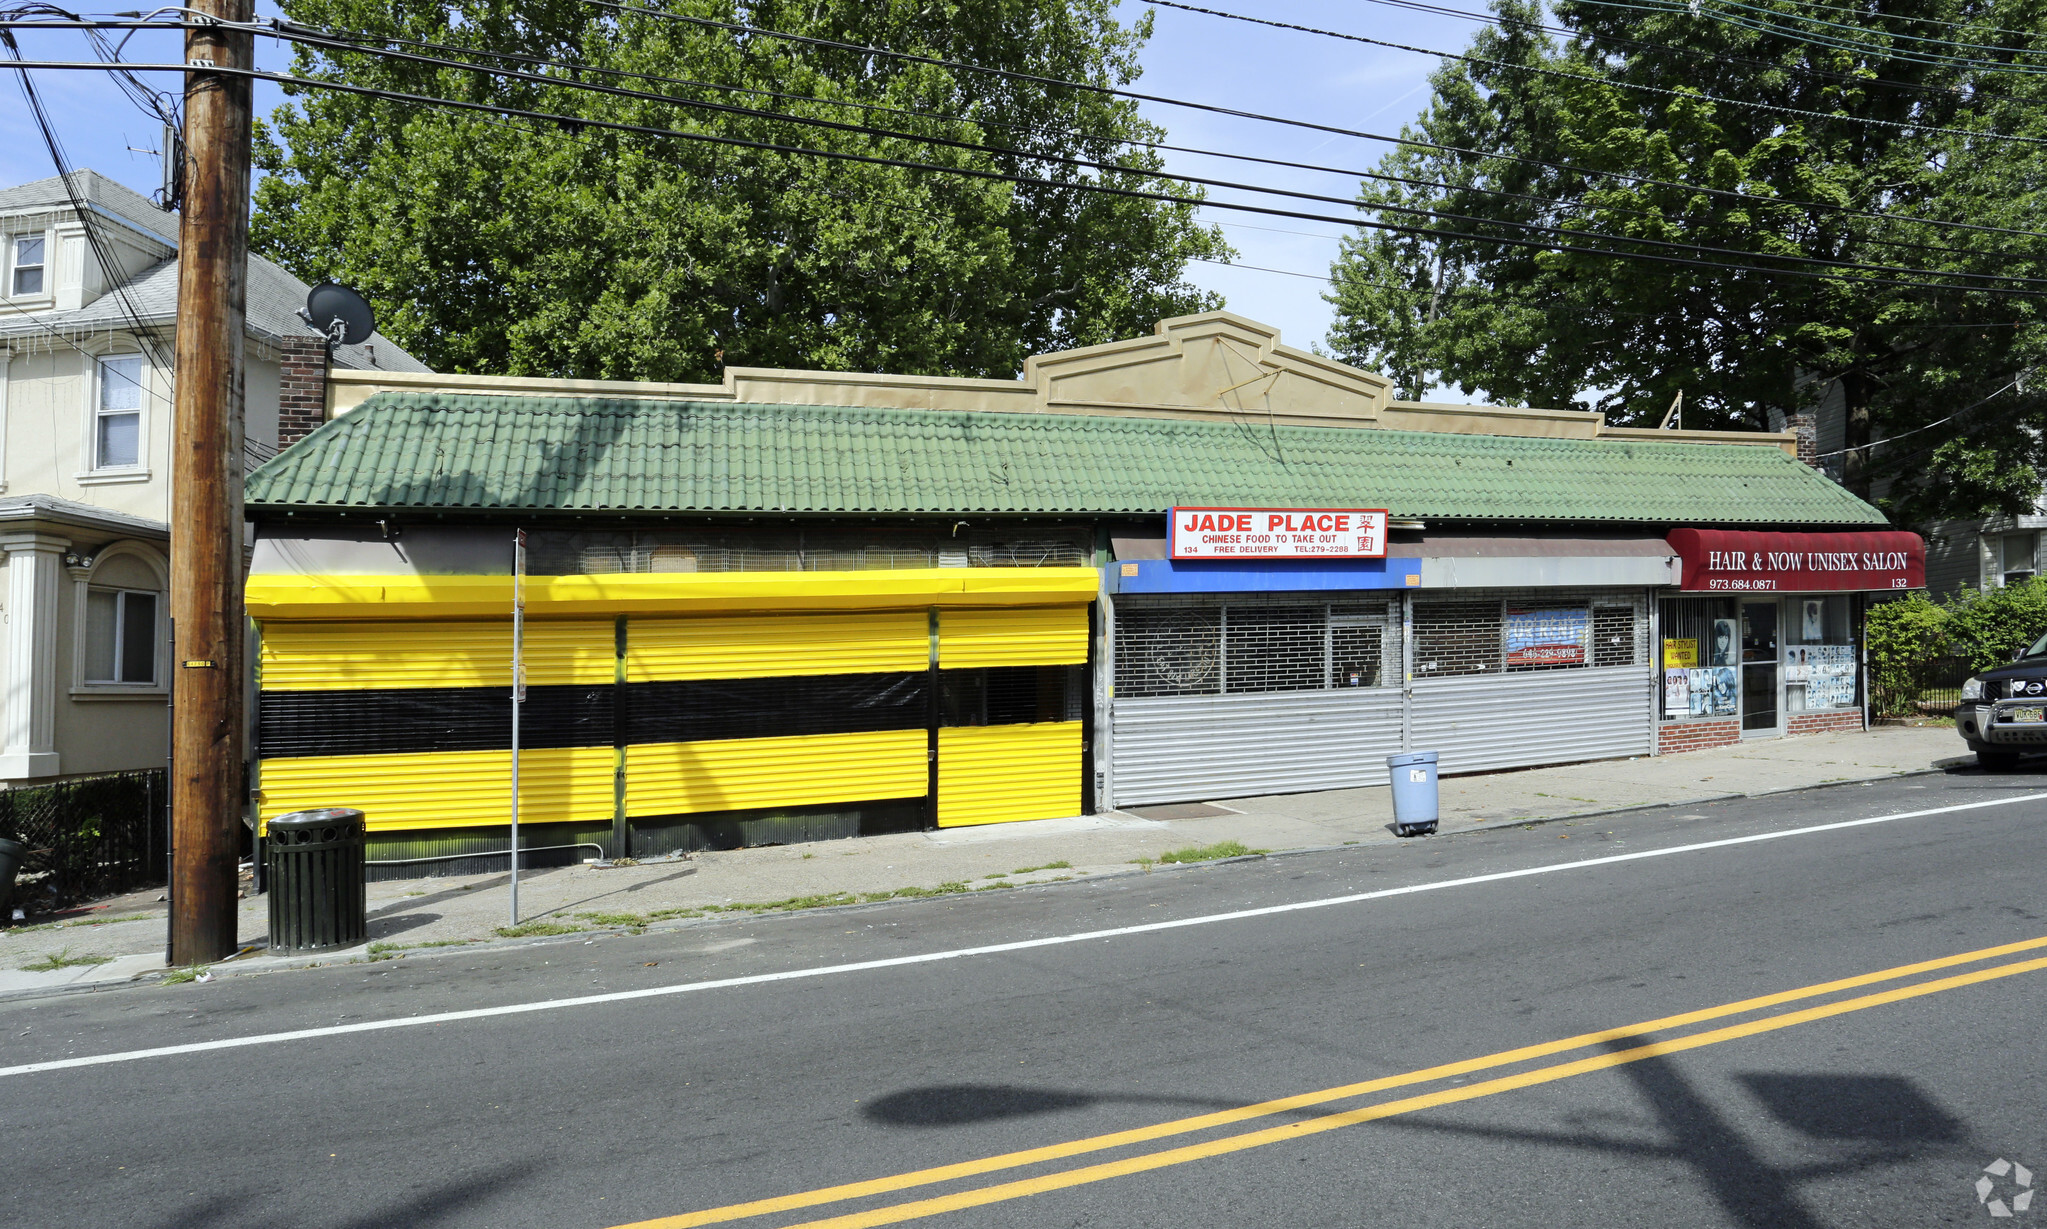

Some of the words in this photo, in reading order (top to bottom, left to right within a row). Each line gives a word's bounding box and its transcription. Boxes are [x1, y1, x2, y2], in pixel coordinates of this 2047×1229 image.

[1184, 514, 1253, 532] JADE
[1268, 515, 1350, 533] PLACE
[1202, 534, 1243, 544] CHINESE
[1245, 534, 1271, 544] FOOD
[1275, 534, 1288, 544] TO
[1291, 534, 1316, 544] TAKE
[1319, 534, 1338, 544] OUT
[1183, 546, 1198, 554] 134
[1239, 545, 1279, 554] DELIVERY
[1294, 545, 1349, 554] TEL:279-2288
[1708, 551, 1748, 571] HAIR
[1752, 552, 1763, 571] &
[1767, 552, 1804, 571] NOW
[1807, 552, 1860, 571] UNISEX
[1863, 551, 1908, 571] SALON
[1709, 578, 1777, 590] 973.684.0871
[1891, 578, 1907, 588] 132
[1665, 640, 1677, 650] HAIR
[1678, 639, 1697, 650] STYLIST
[1670, 651, 1692, 660] WANTED
